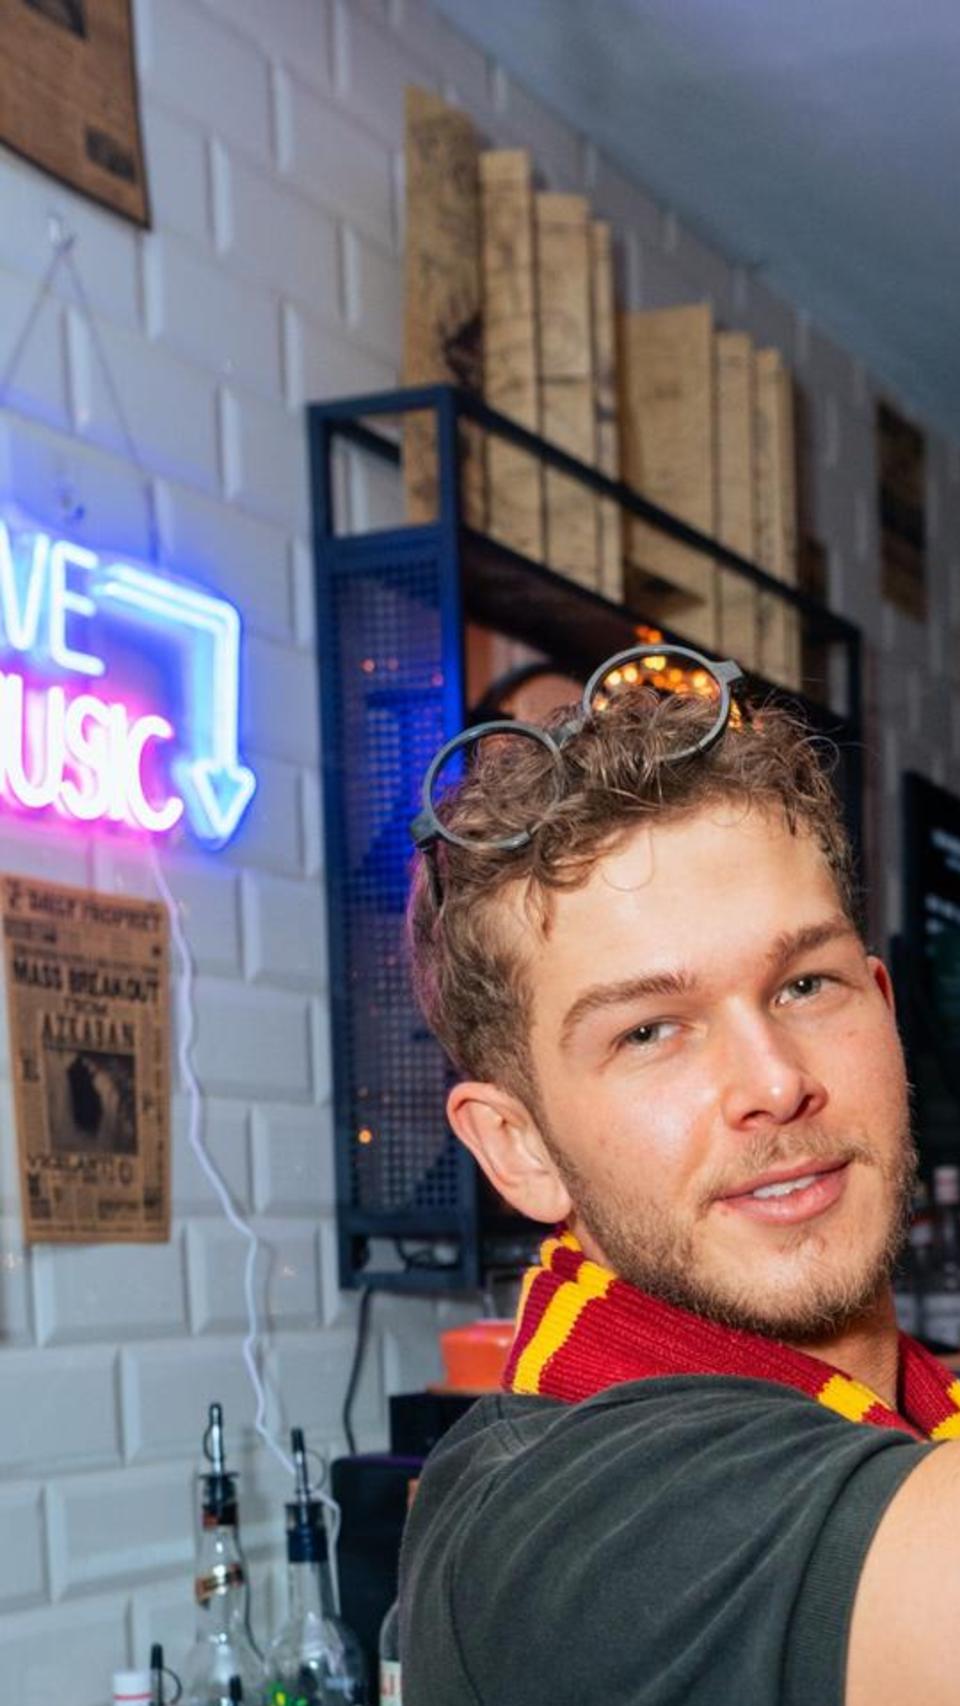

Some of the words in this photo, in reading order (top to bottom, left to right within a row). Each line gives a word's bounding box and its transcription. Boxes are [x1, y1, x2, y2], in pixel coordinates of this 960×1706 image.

[0, 672, 184, 832] USIC
[13, 956, 63, 990] MASS
[69, 966, 160, 1004] BREAKOUT
